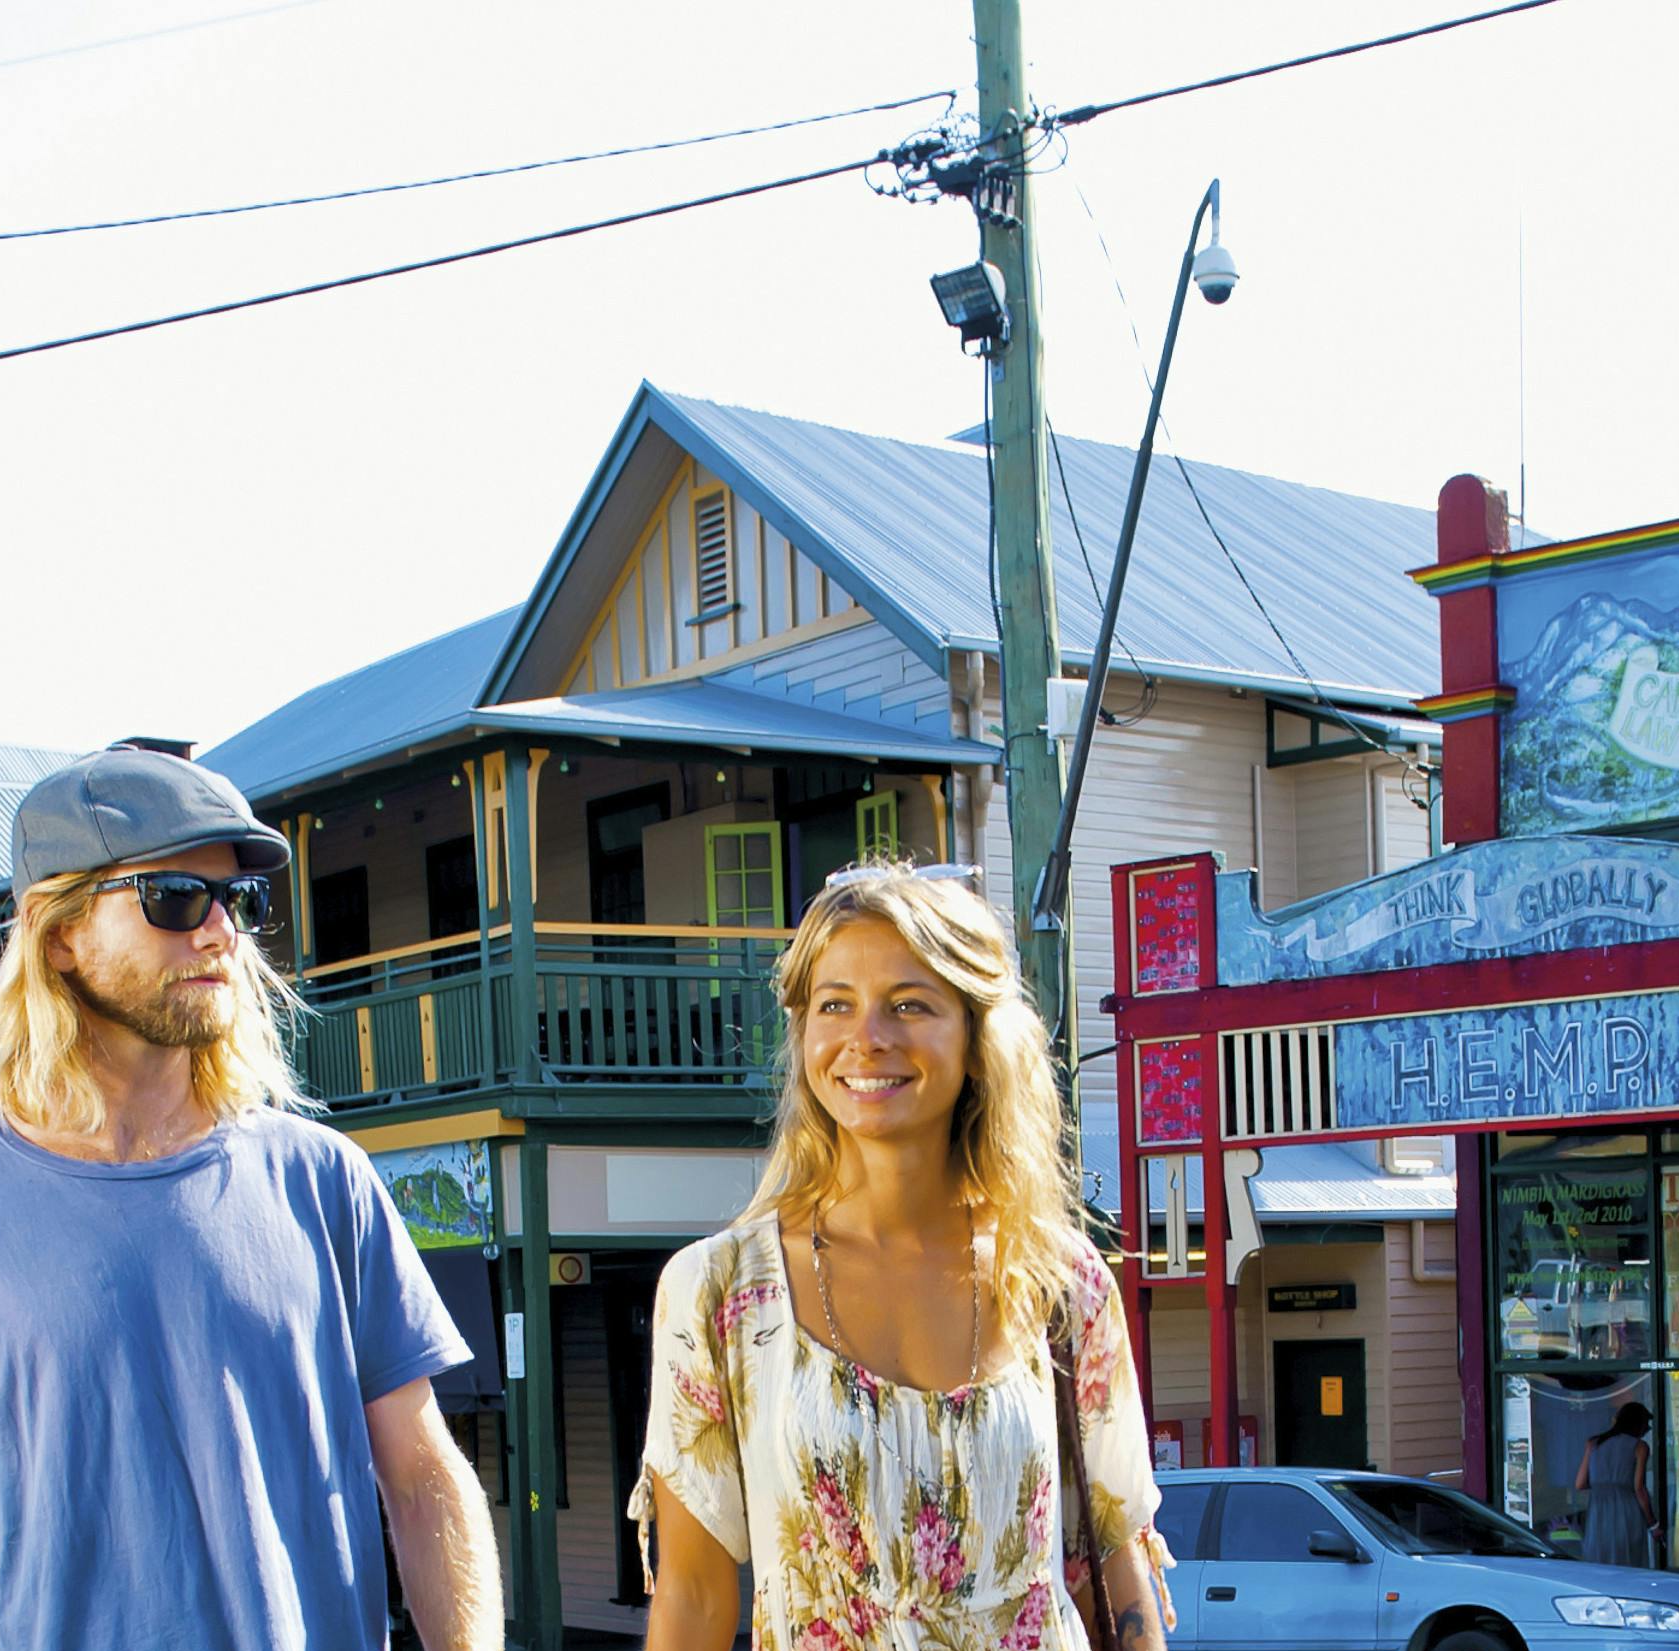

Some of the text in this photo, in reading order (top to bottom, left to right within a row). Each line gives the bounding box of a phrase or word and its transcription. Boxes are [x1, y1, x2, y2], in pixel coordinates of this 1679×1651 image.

[1388, 864, 1668, 931] THINK GLOBALLY
[1389, 1016, 1651, 1110] H.E.M.P.
[1502, 1187, 1552, 1204] NIMBIN
[1522, 1210, 1548, 1228] May
[1601, 1205, 1634, 1222] 2010
